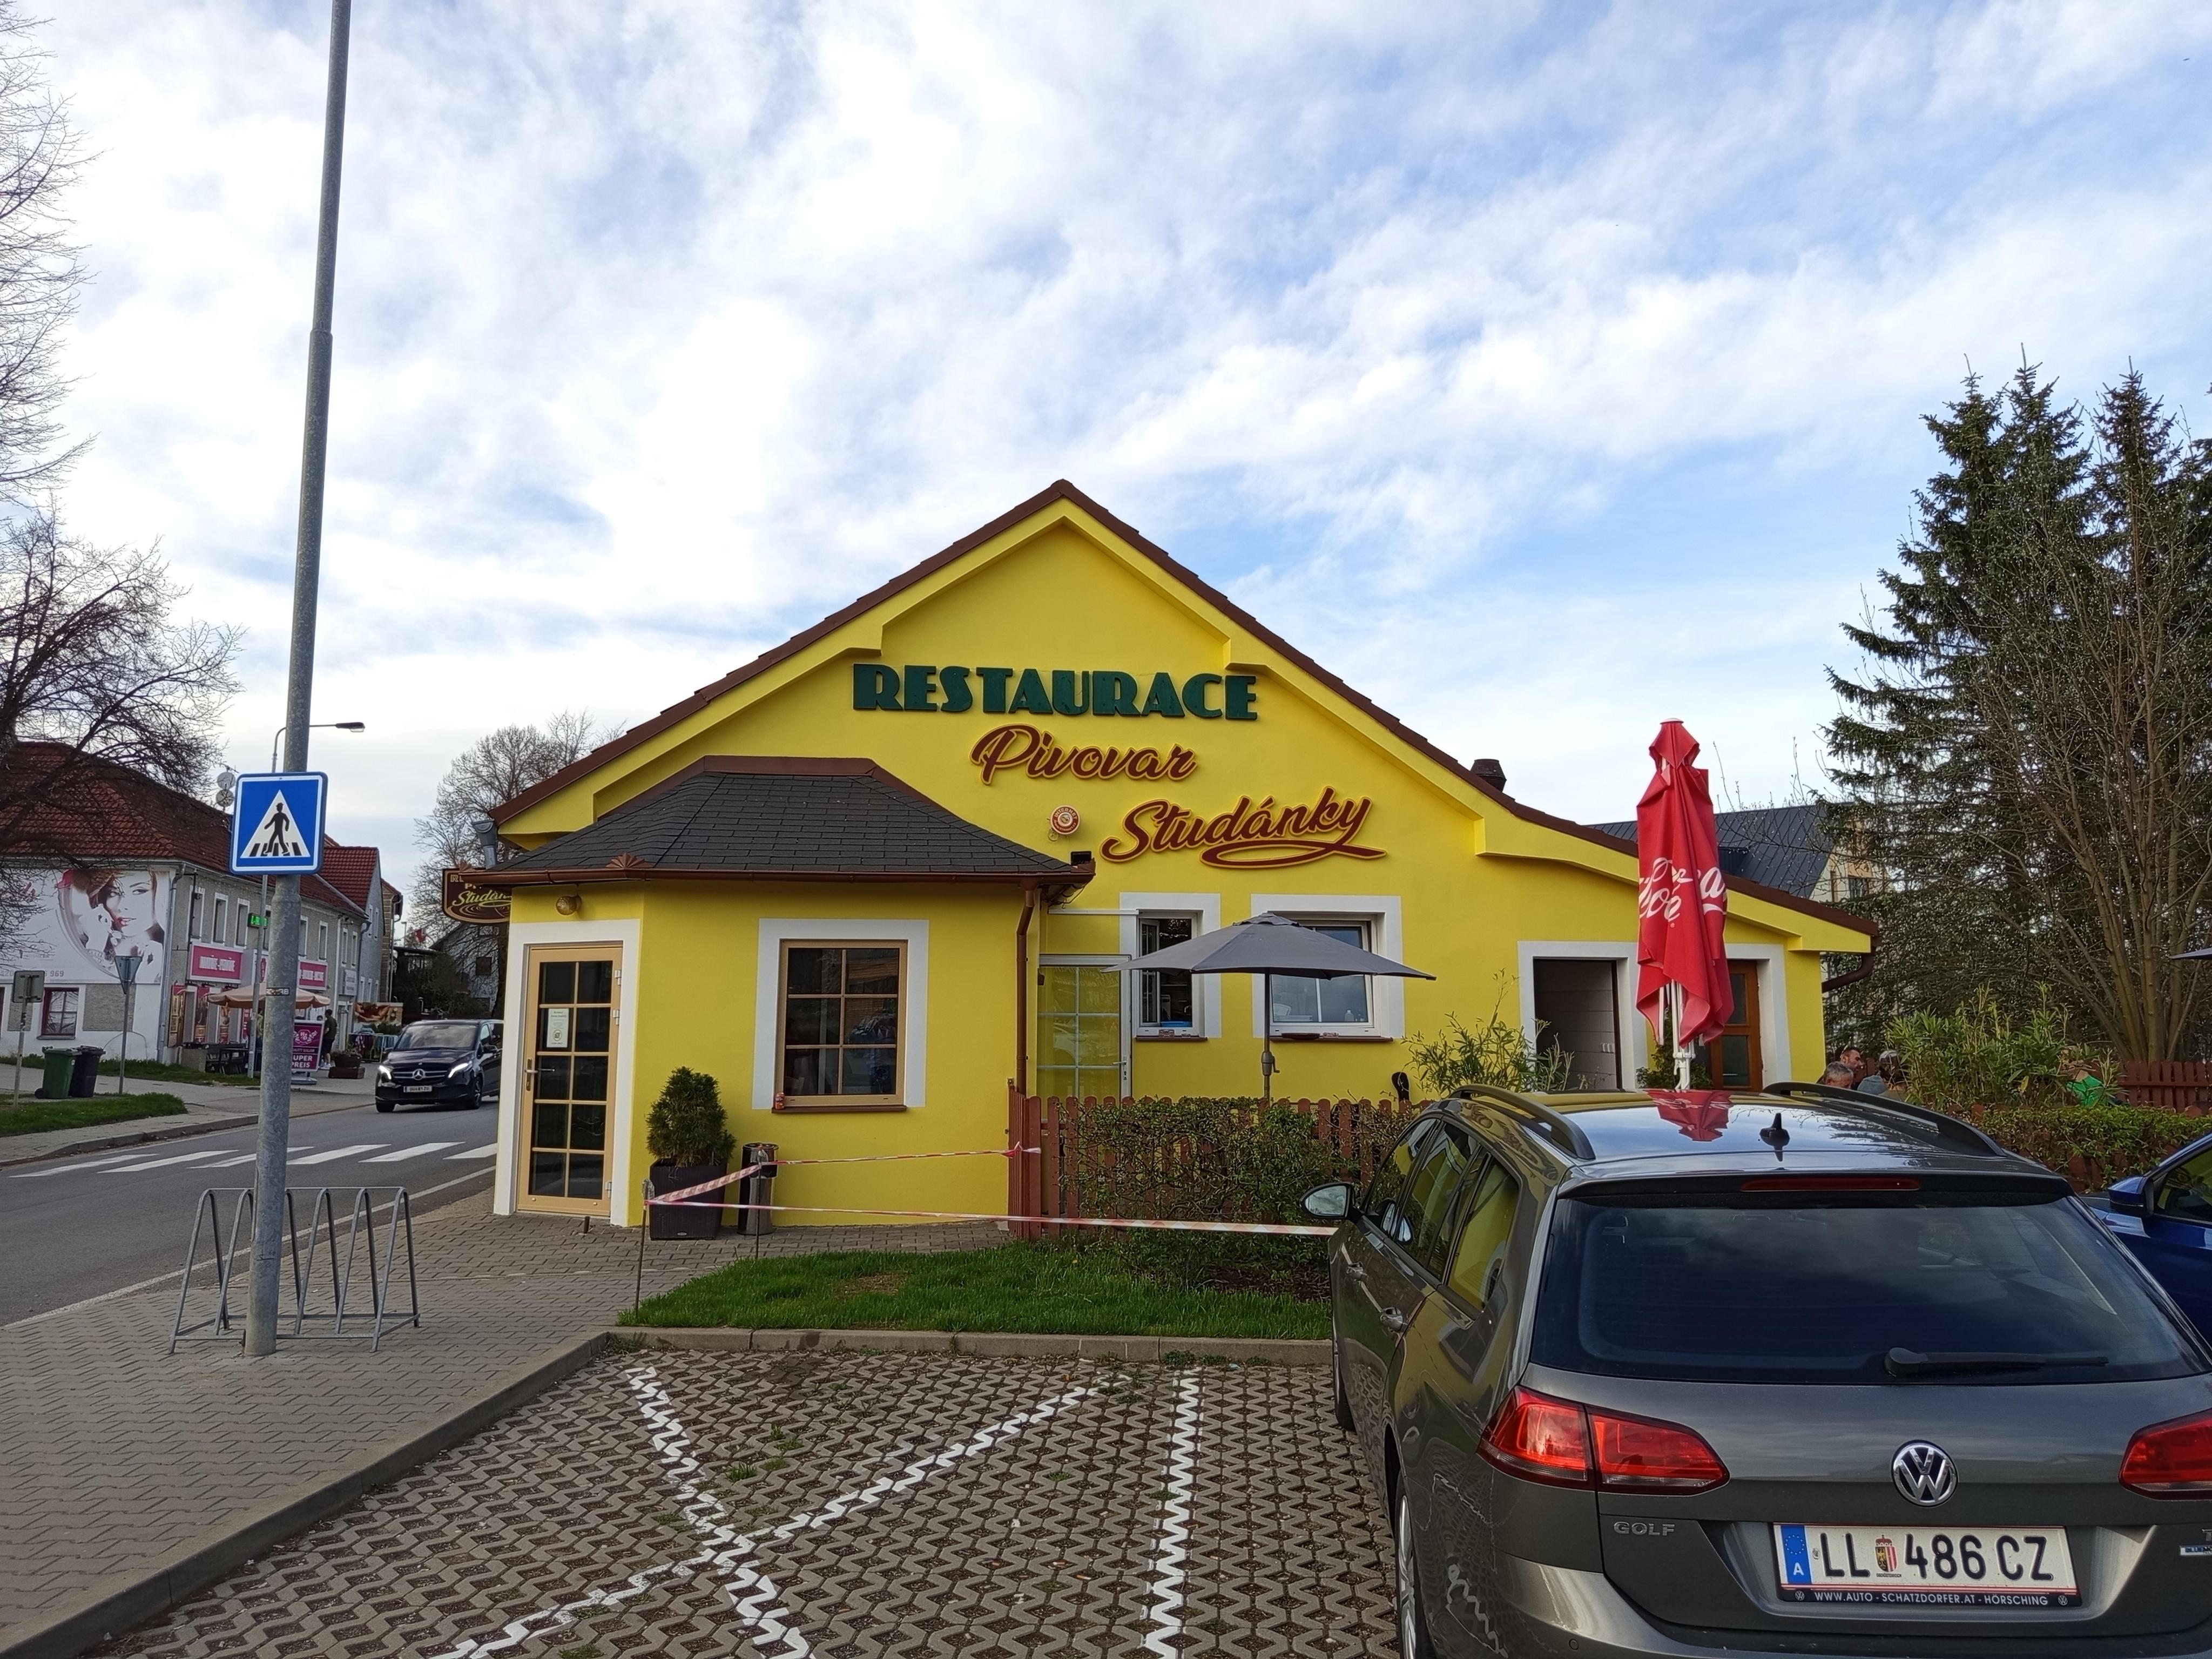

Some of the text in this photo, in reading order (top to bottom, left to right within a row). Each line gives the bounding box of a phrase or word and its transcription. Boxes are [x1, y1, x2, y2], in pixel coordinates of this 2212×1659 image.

[853, 663, 1258, 720] RESTAURACE
[970, 723, 1198, 785] Pivovar
[1054, 807, 1077, 820] INTERNET
[1100, 786, 1386, 868] Studánky
[1614, 1521, 1675, 1536] GOLF
[1792, 1533, 2054, 1581] A LL 486 CZ
[1814, 1592, 1873, 1602] WWW.AUTO
[1881, 1593, 1975, 1604] SCHATZDORFER.AT
[1984, 1594, 2048, 1606] HÖRSCHING
